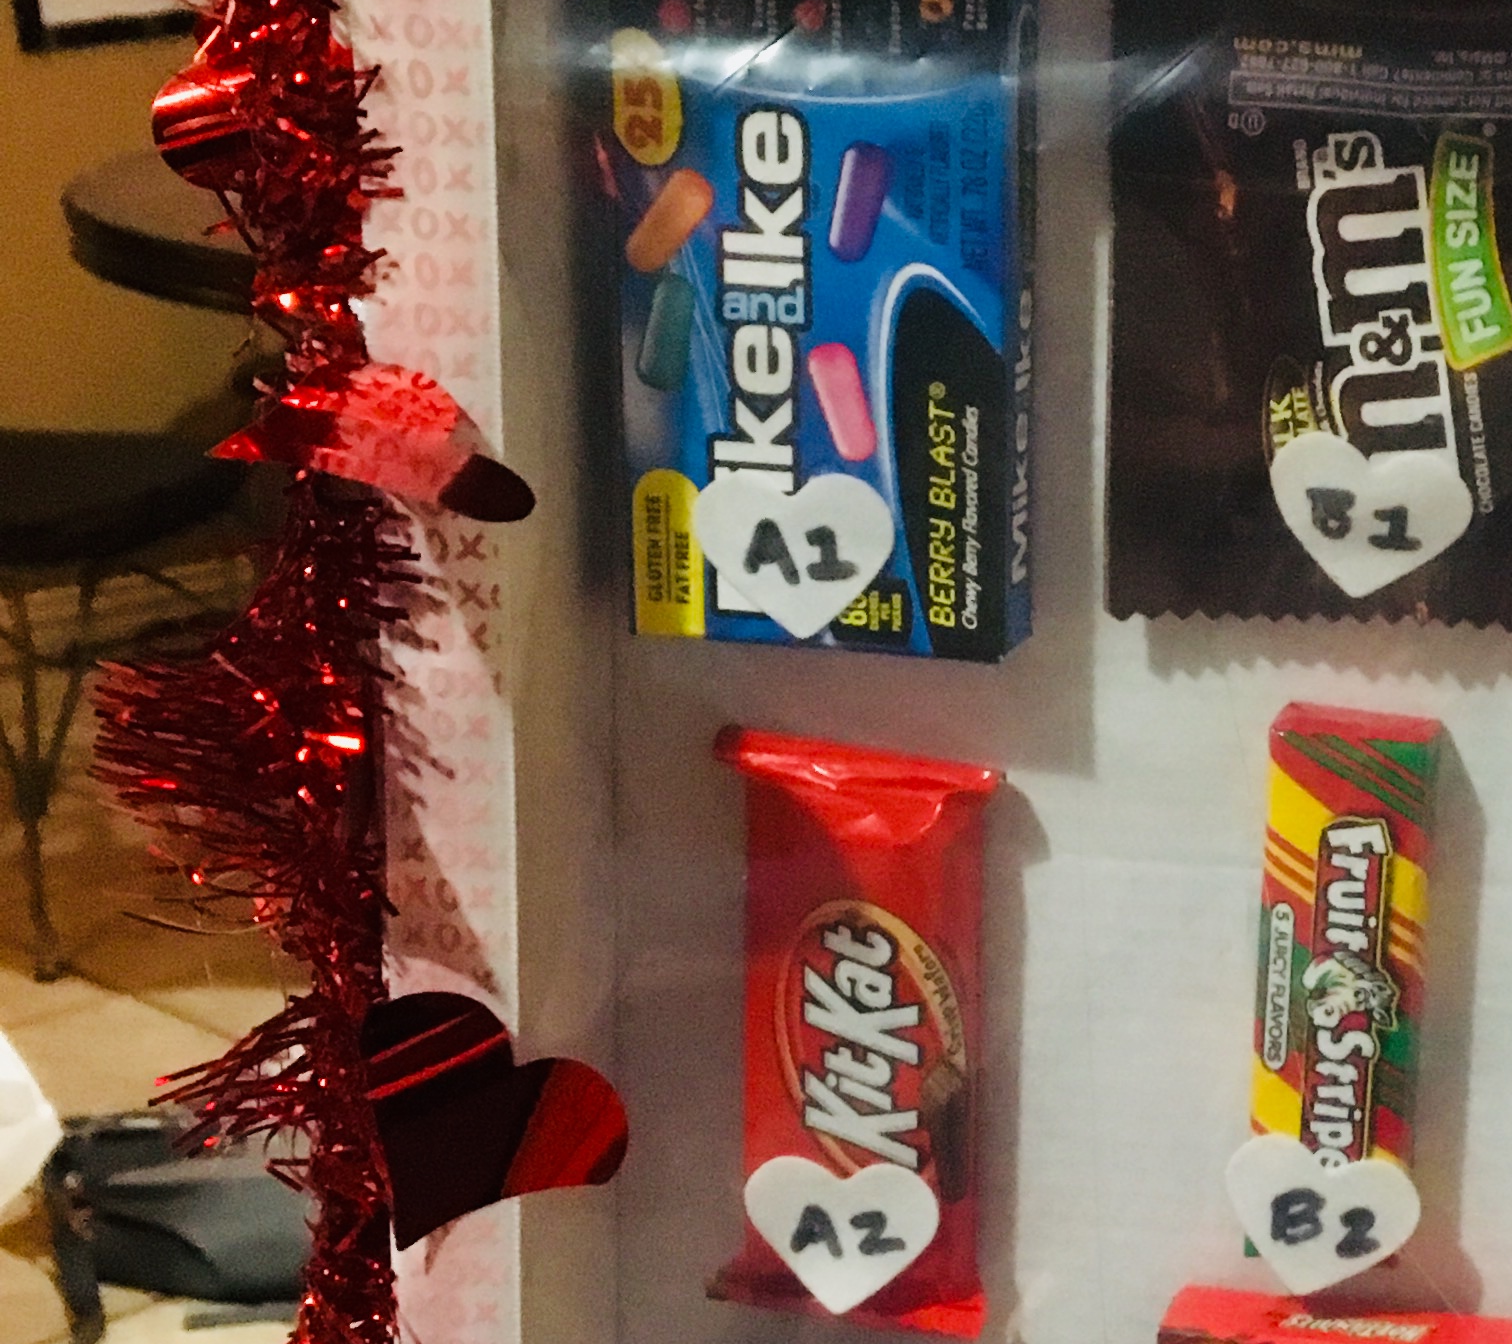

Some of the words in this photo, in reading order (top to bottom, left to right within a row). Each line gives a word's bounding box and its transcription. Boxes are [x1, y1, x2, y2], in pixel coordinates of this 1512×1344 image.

[1443, 150, 1480, 249] SIZE
[721, 286, 805, 328] and
[1445, 259, 1502, 345] FUN
[1462, 372, 1484, 432] CANDIES
[963, 405, 980, 466] Candies
[961, 469, 979, 533] Flavored
[1471, 434, 1495, 514] CHOCOLATE
[674, 531, 689, 570] FREE
[744, 517, 860, 588] A1
[928, 518, 956, 627] BERRY
[962, 536, 982, 576] Berry
[675, 575, 690, 604] FAT
[961, 580, 980, 630] Chewy
[1325, 823, 1384, 954] Fruit
[789, 1204, 907, 1258] A2
[1269, 1188, 1380, 1257] B2
